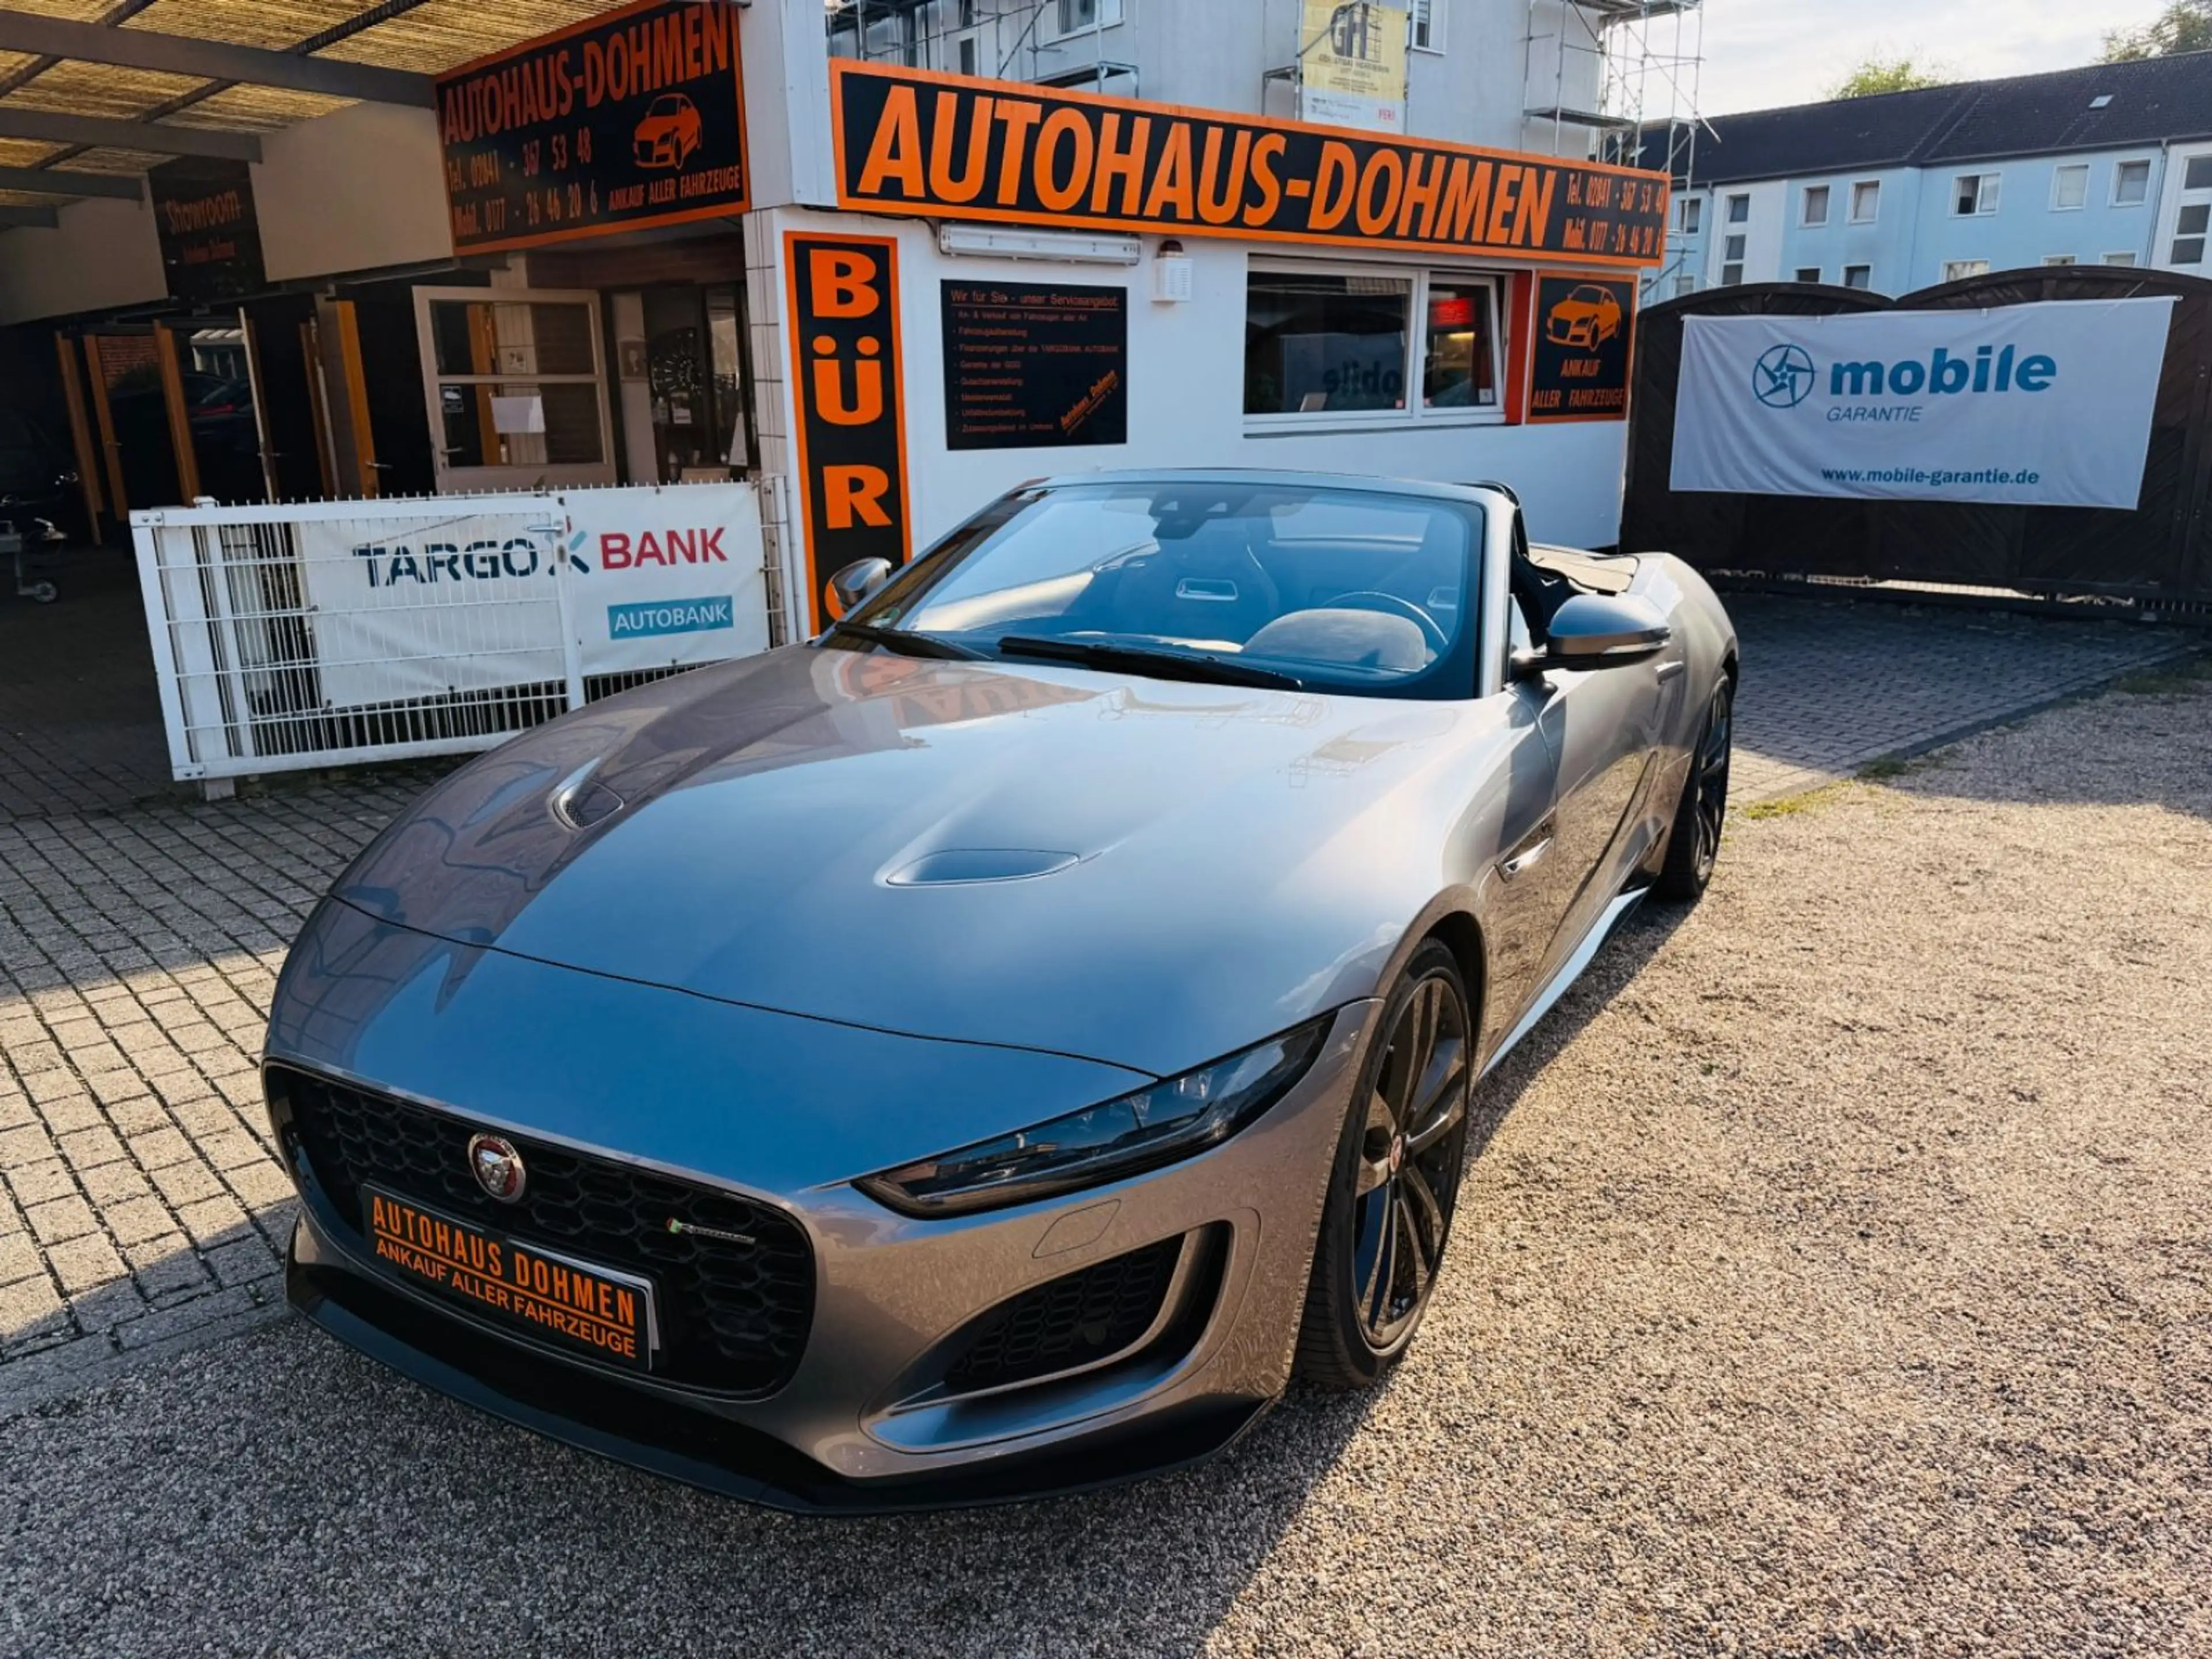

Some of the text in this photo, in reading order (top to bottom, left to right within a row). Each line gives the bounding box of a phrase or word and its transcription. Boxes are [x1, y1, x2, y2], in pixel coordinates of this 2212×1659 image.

[444, 1, 729, 145] AUTOHAUS-DOHMEN
[552, 134, 567, 171] 53
[578, 126, 592, 164] 48
[857, 84, 1557, 248] AUTOHAUS-DOHMEN
[567, 181, 581, 218] 20
[608, 166, 741, 211] ANKAUF ALLER FAHRZEUGE
[165, 189, 241, 235] Showroom
[951, 290, 968, 302] Wir
[1560, 358, 1601, 378] ANKAUF
[1830, 343, 2058, 397] mobile
[1532, 387, 1626, 409] ALLER FAHRZEUGE
[1826, 404, 1922, 424] GARANTIE
[809, 248, 894, 623] BÜR
[1821, 466, 2040, 487] www.mobile-garantie.de
[353, 527, 728, 588] TARGO BANK
[613, 602, 729, 634] AUTOBANK
[373, 1195, 635, 1325] AUTOHAUS DOHMEN
[376, 1238, 637, 1359] ANKAUF ALLER FAHRZEUGE
